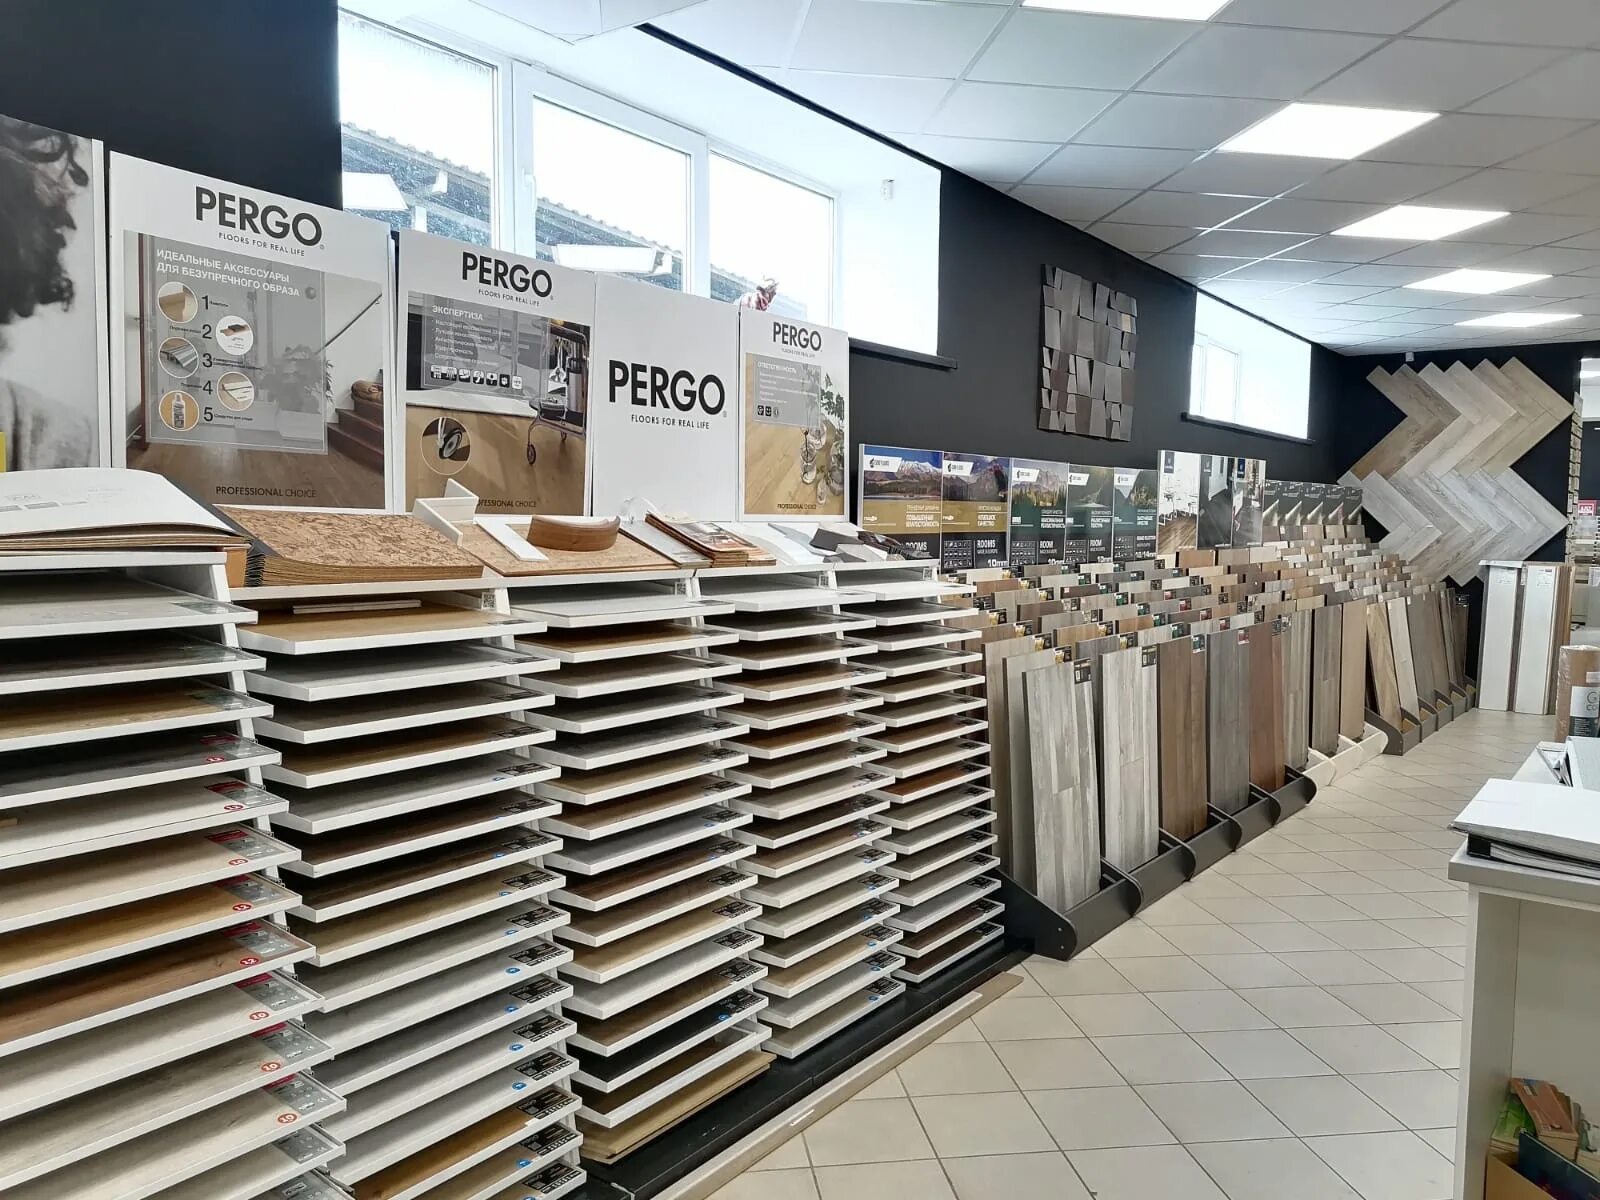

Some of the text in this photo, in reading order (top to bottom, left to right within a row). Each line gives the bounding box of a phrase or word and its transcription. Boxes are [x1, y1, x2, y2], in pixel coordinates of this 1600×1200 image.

[196, 186, 322, 246] PERGO
[219, 232, 305, 256] FLOORS FOR REAL LIFE
[157, 249, 289, 283] ИДЕАЛЬНЫЕ АКСЕССУАРЫ
[156, 262, 300, 297] ДЛЯ БЕЗУПРЕЧНОГО ОБРАЗА
[462, 252, 552, 298] PERGO
[202, 296, 209, 310] 1
[478, 289, 501, 299] FLOORS
[502, 293, 514, 302] FOR
[515, 297, 528, 305] REAL
[432, 305, 483, 321] ЭКСПЕРТИЗА
[202, 324, 212, 339] 2
[773, 321, 822, 352] PERGO
[202, 353, 213, 368] 3
[203, 380, 213, 395] 4
[609, 360, 725, 415] PERGO
[203, 407, 214, 421] 5
[631, 414, 710, 430] FLOORS FOR REAL LIFE
[216, 486, 316, 498] PROFESSIONAL CHOICE
[478, 499, 513, 508] FESSIONAL
